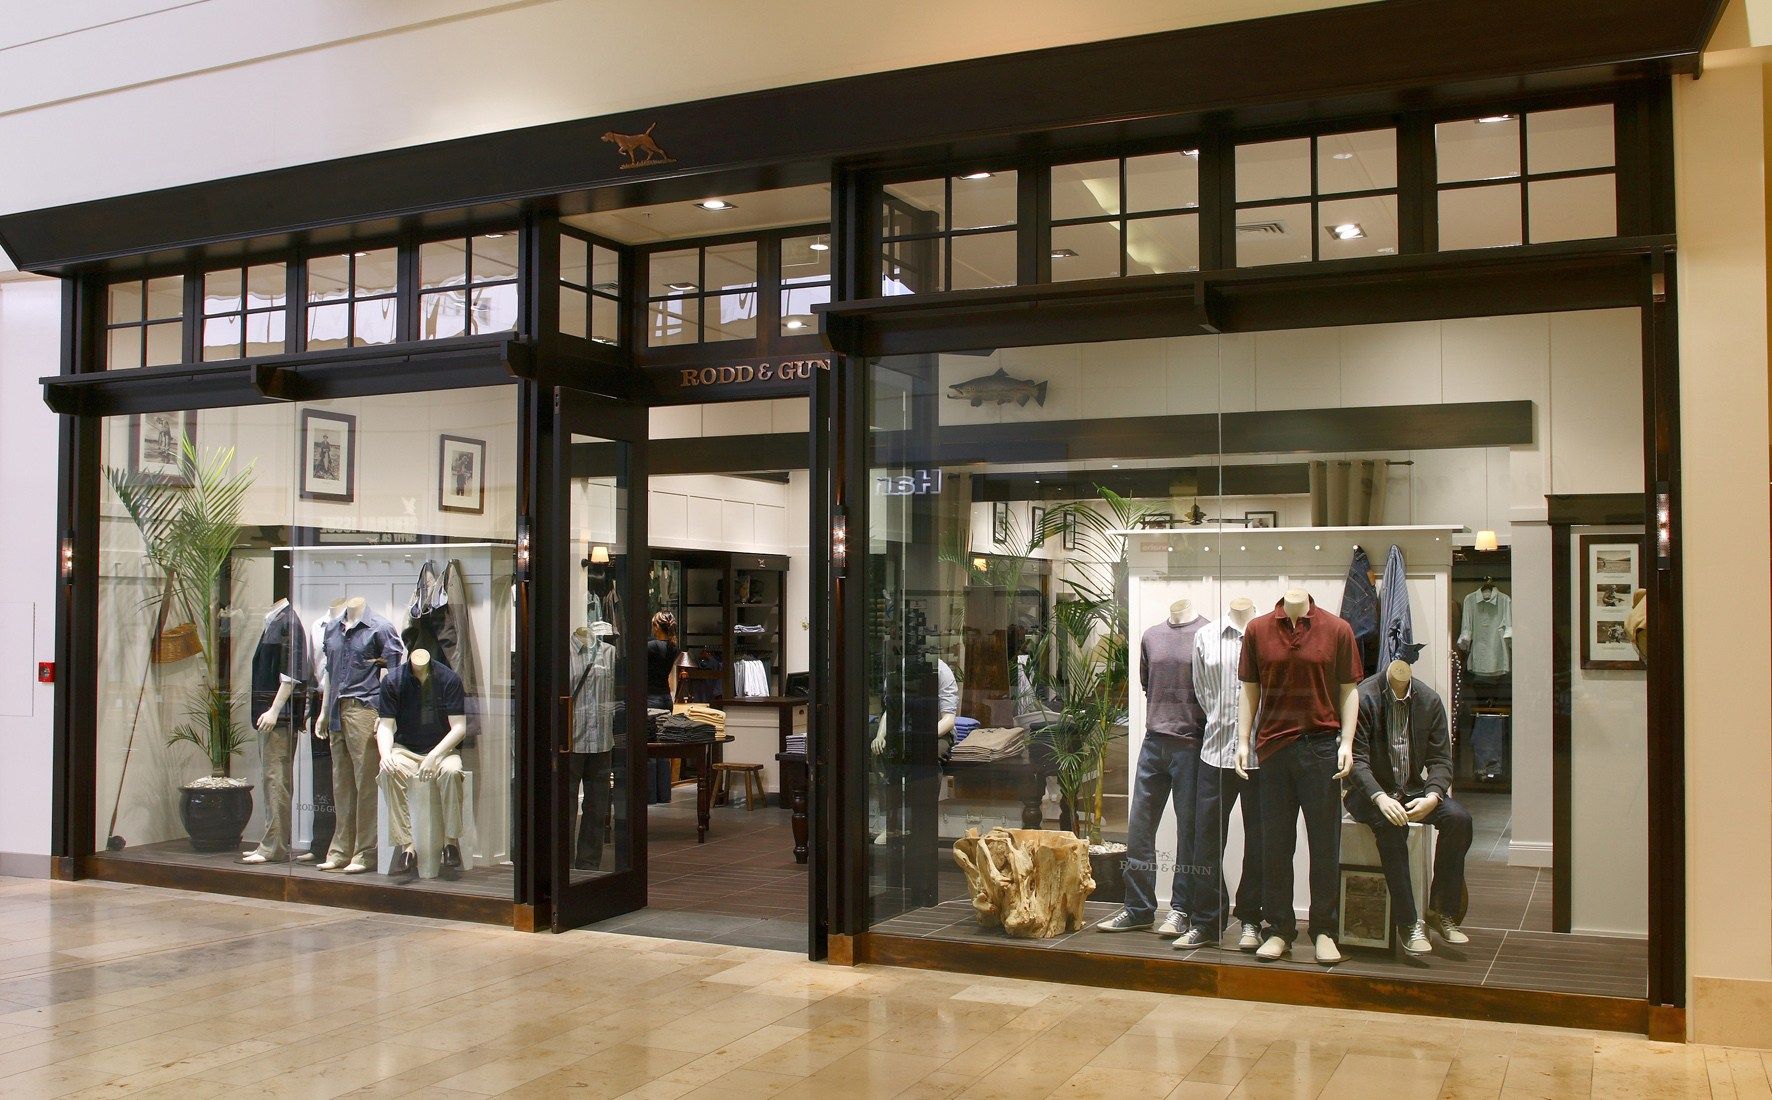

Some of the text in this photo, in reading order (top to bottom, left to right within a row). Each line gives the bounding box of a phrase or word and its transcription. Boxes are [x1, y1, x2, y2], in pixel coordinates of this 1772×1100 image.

[680, 364, 755, 387] RODD
[758, 363, 774, 381] &
[1120, 860, 1212, 876] RODD & GUNN
